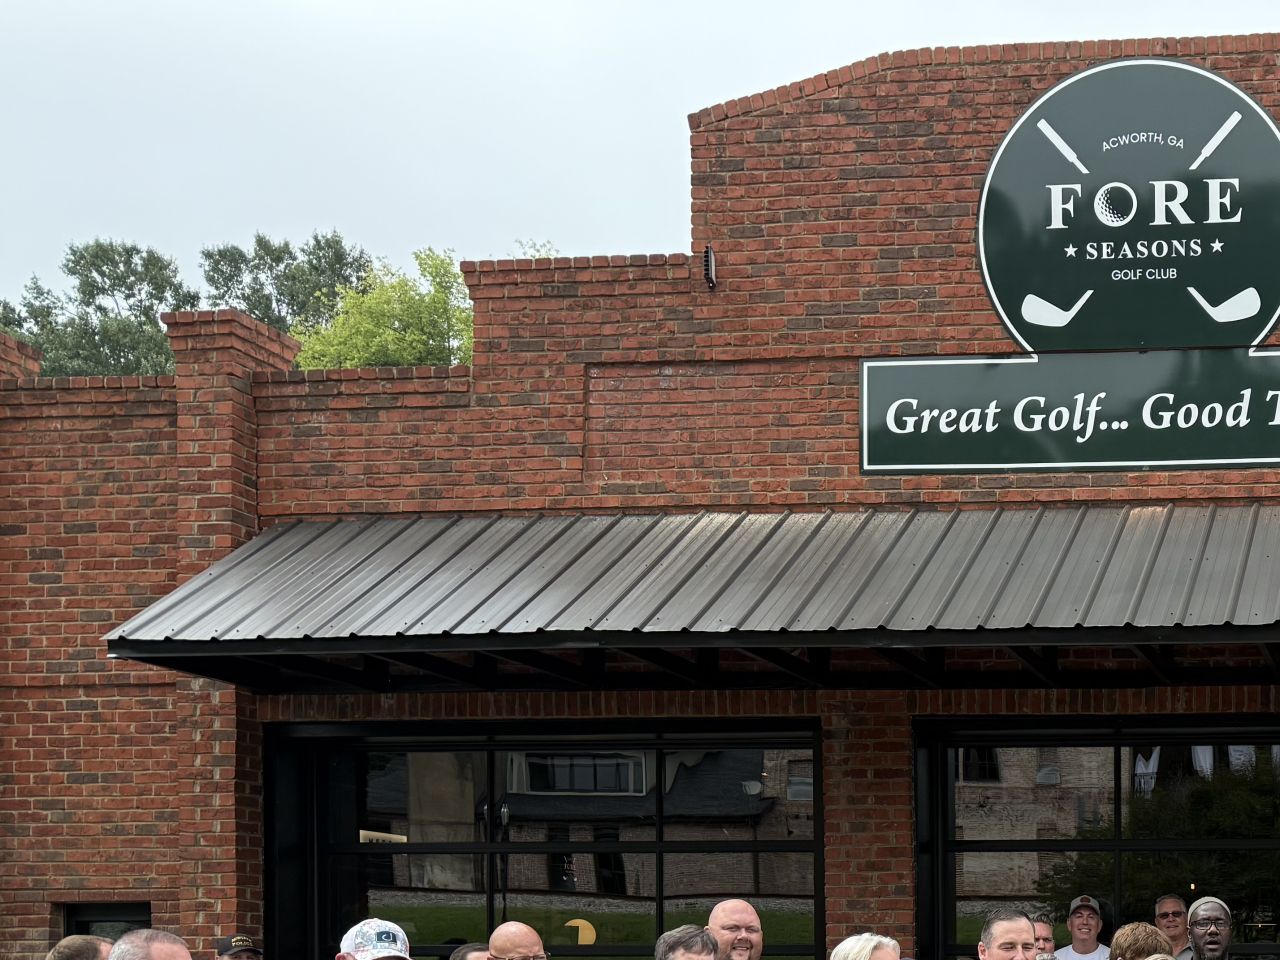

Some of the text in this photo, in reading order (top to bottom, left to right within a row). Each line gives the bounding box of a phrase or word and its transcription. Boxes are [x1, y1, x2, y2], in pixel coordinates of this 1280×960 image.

[1102, 132, 1184, 152] ACWORTH, GA
[1046, 178, 1243, 230] FORE
[1086, 239, 1202, 260] SEASONS
[1111, 268, 1177, 281] GOLF CLUB
[886, 398, 1002, 434] Great
[1014, 392, 1129, 443] Golf...
[1142, 389, 1252, 430] Good
